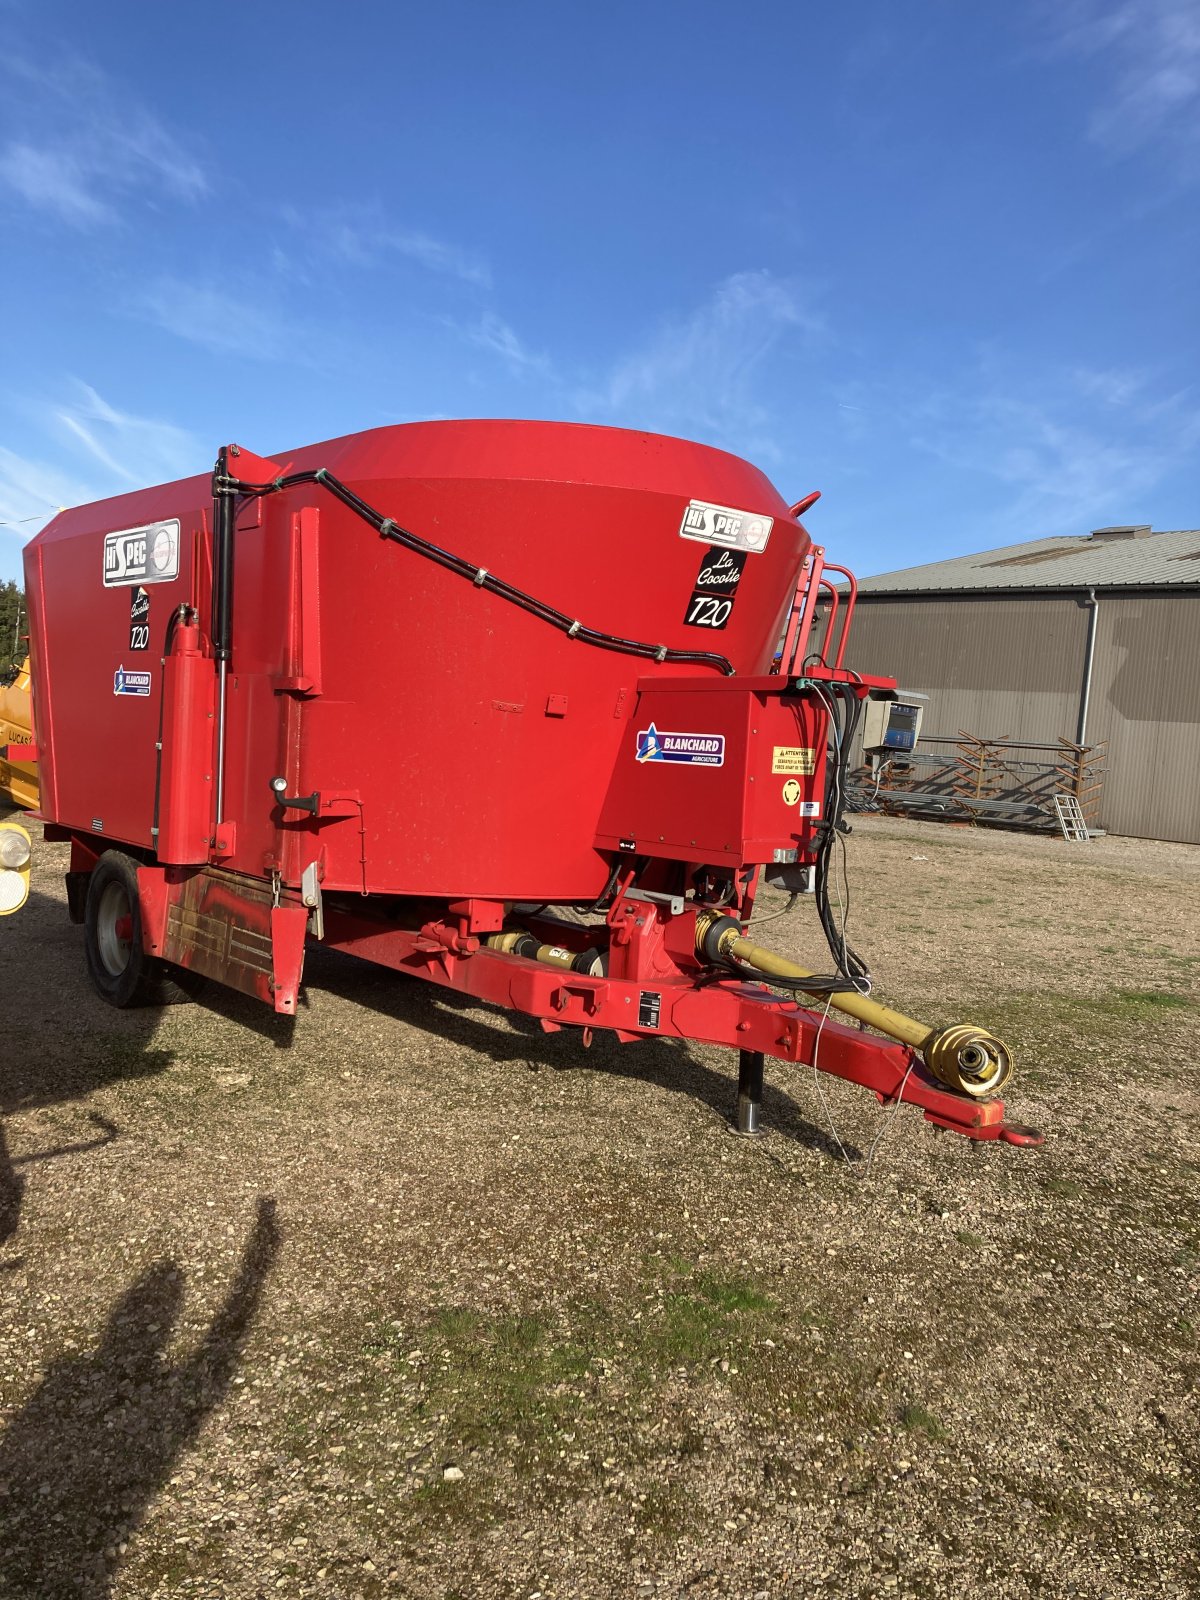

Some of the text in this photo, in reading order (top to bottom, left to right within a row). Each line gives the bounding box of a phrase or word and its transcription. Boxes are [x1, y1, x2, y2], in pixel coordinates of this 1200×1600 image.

[712, 551, 734, 568] La
[697, 567, 741, 585] Cocotte
[688, 597, 732, 627] T20
[131, 626, 149, 649] T20
[126, 675, 149, 685] BLANCHARD
[664, 738, 720, 752] BLANCHARD
